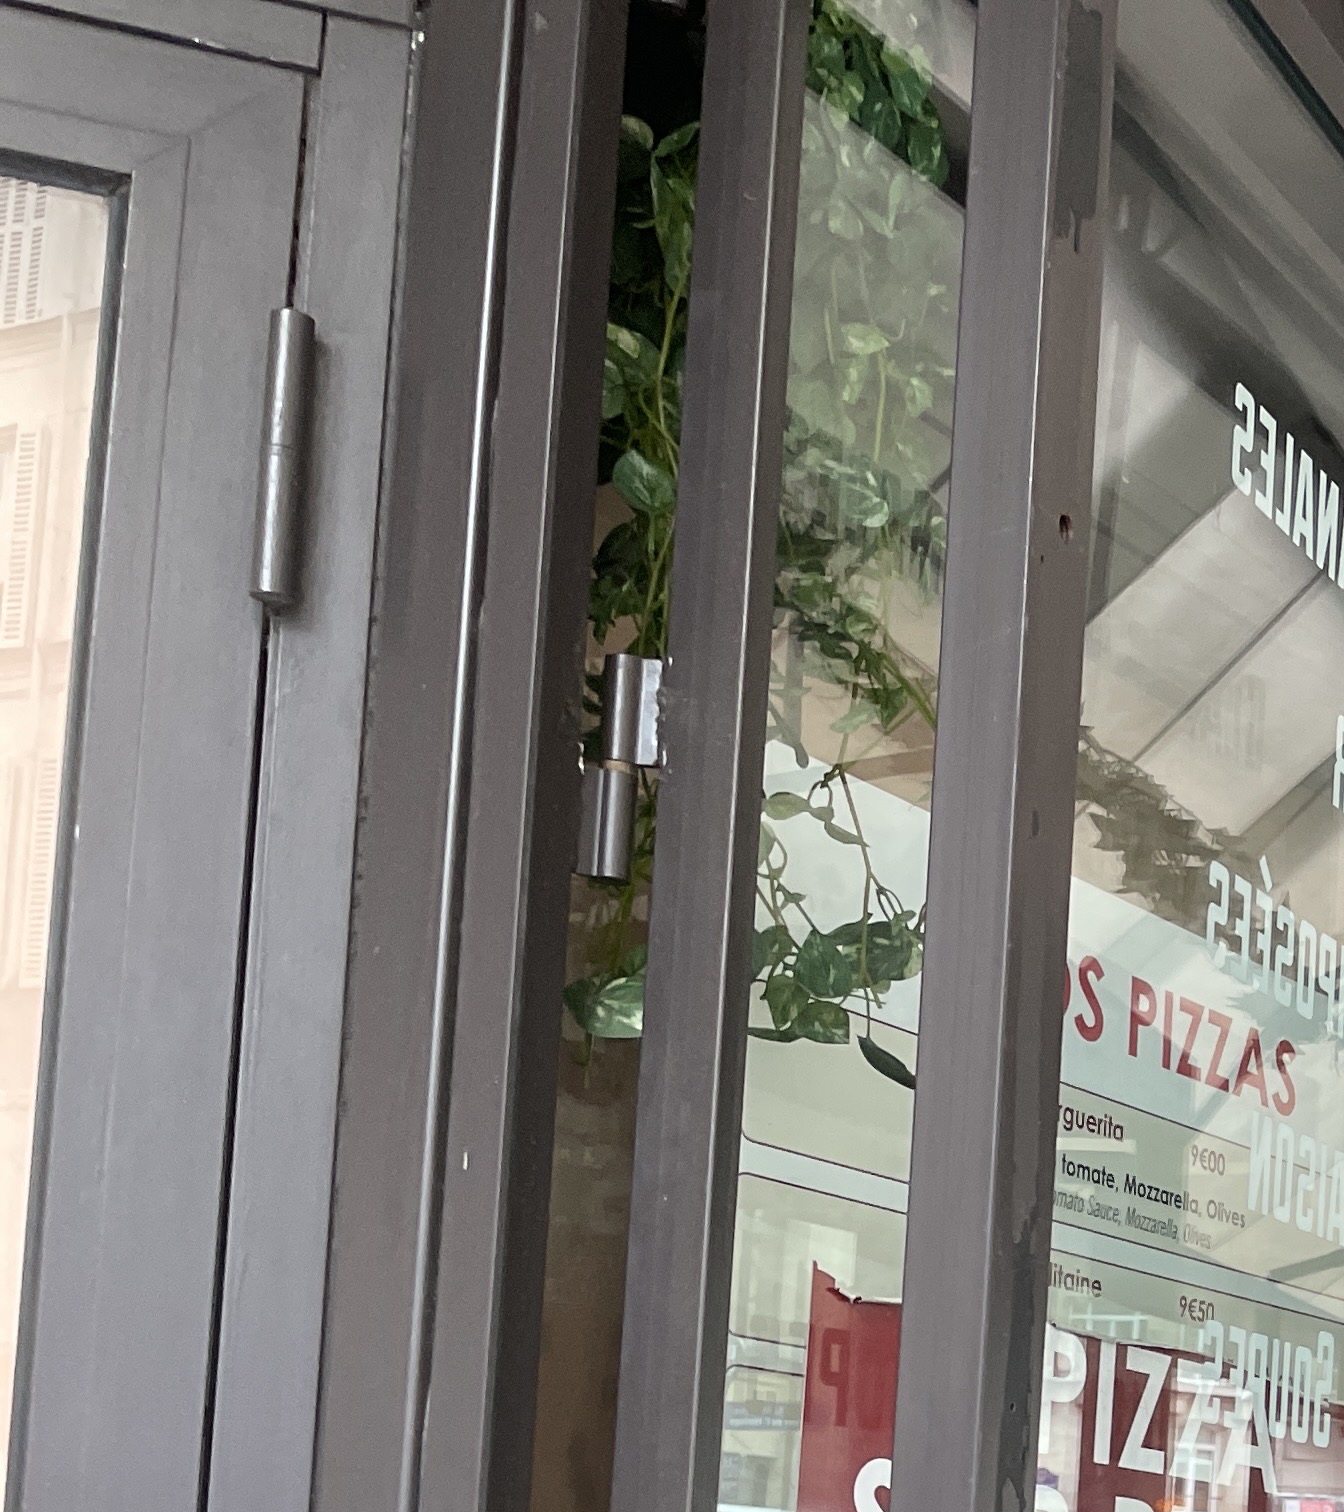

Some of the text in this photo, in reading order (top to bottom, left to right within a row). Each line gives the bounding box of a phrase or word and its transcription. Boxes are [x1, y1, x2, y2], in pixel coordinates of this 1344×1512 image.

[1128, 975, 1297, 1117] PIZZAS
[1062, 1153, 1246, 1229] tomate, Mozzarella, Olives
[1191, 1145, 1226, 1176] 9€00
[1041, 1322, 1277, 1497] PIZZA
